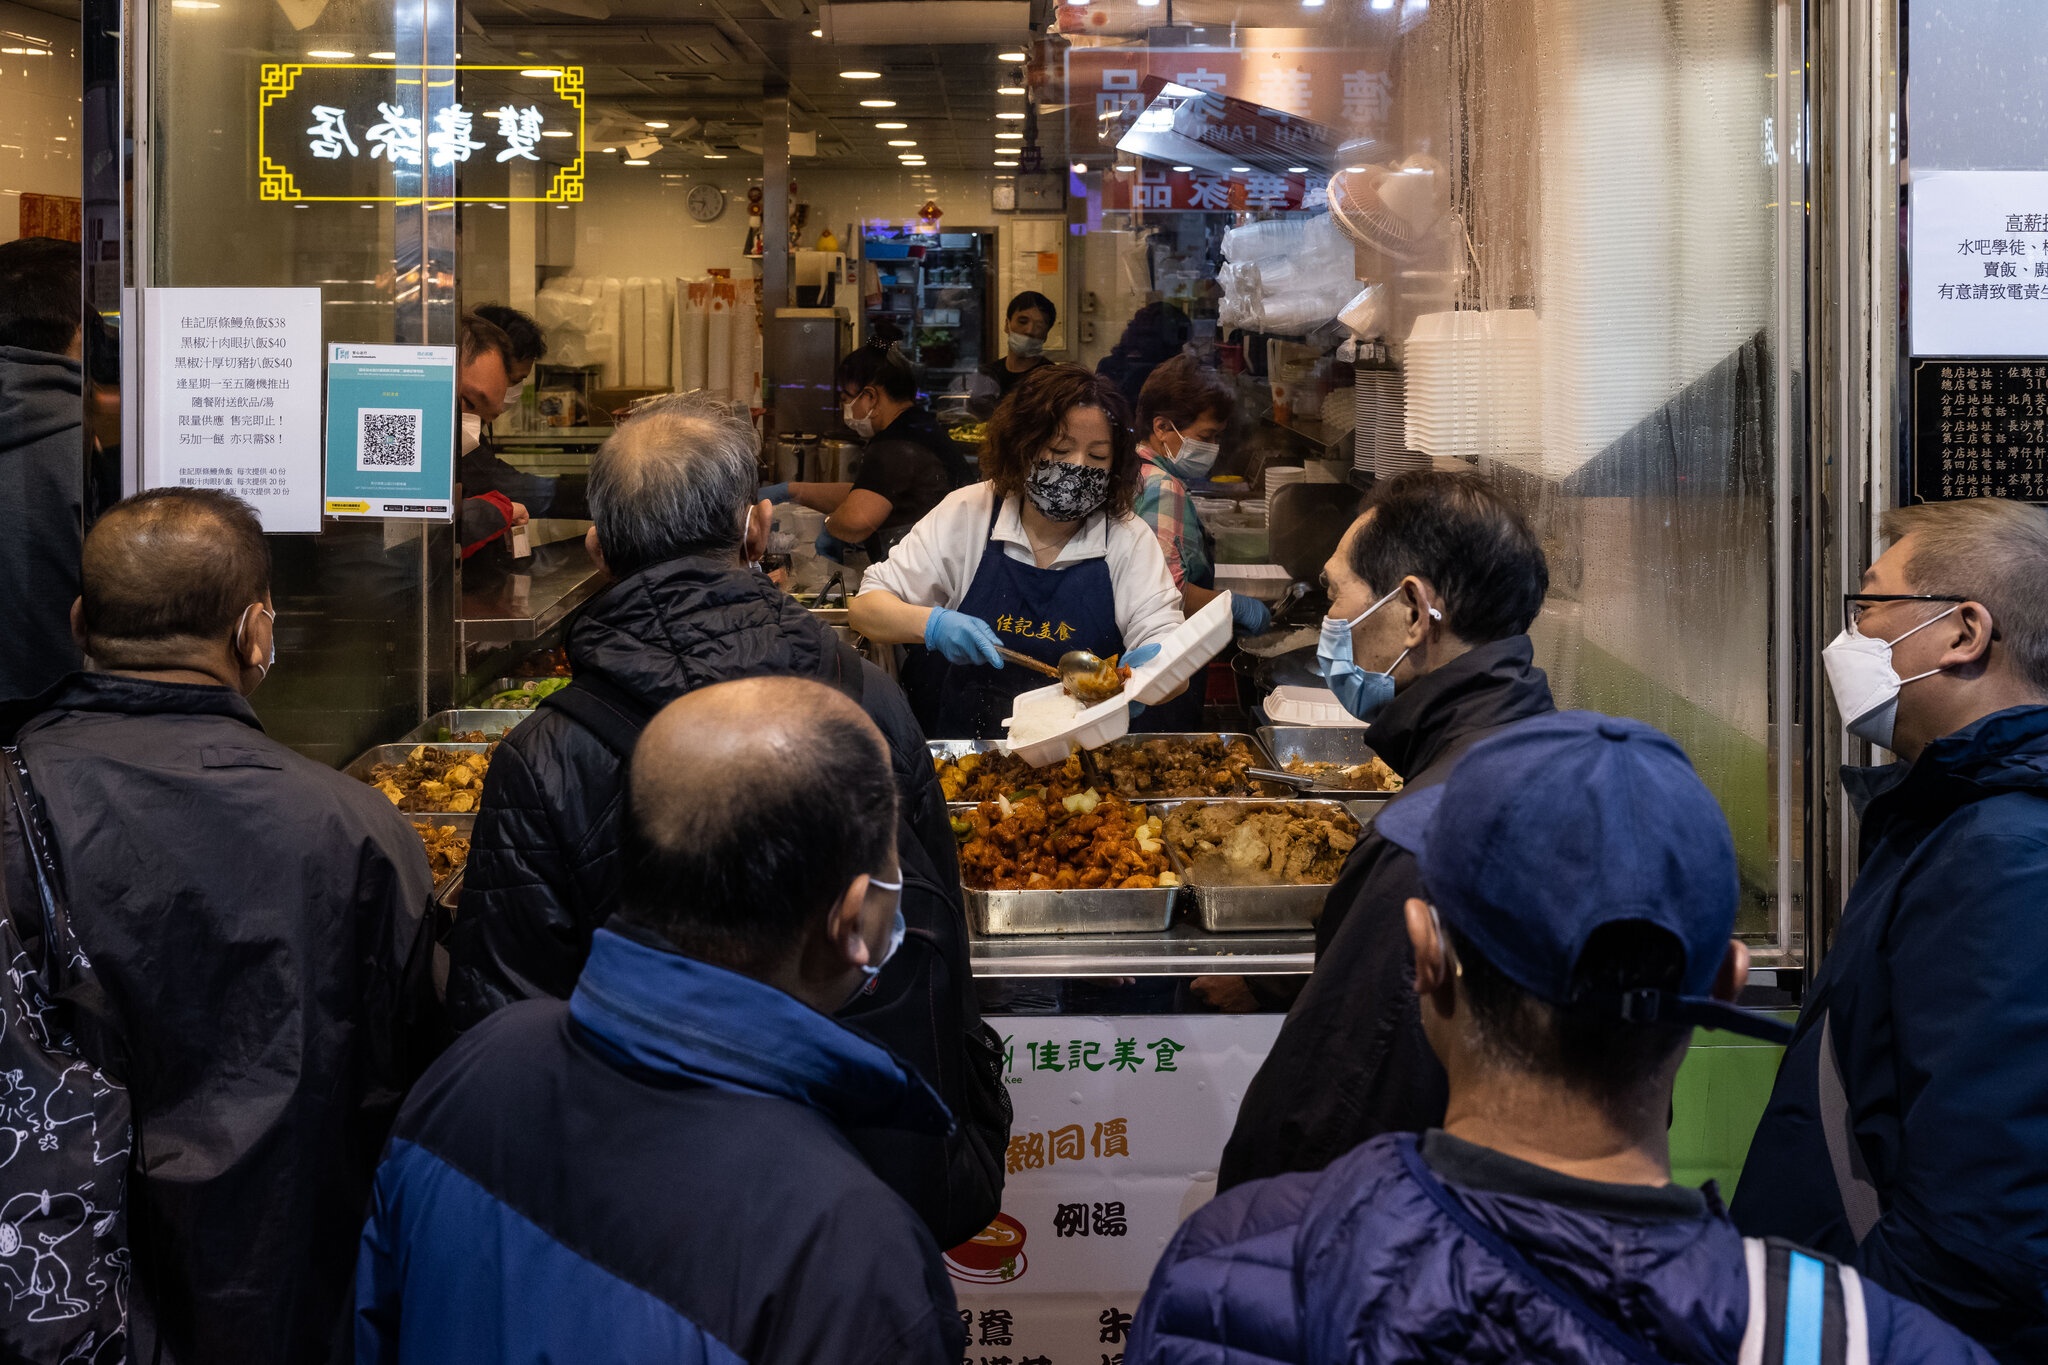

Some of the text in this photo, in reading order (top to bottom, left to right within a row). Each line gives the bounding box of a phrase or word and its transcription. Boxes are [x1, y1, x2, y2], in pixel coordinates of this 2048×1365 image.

[181, 316, 286, 329] 佳記原條鰻魚飯$38
[181, 336, 286, 349] 黑椒汁肉眼扒飯$40
[174, 356, 293, 369] 黑椒汁厚切豬扒飯$40
[176, 378, 290, 390] 逢星期一至五隨機推出
[191, 396, 274, 408] 隨餐附送飲品/湯
[2026, 405, 2048, 416] 25
[178, 415, 283, 426] 限量供應 售完即止！
[1941, 420, 2048, 432] 分店地址：長沙灣
[230, 433, 283, 445] 亦只需$8！
[2026, 432, 2048, 443] 26
[237, 467, 267, 475] 每次提供
[278, 467, 286, 475] 份
[237, 477, 267, 486] 每次提供
[269, 478, 277, 486] 20
[278, 477, 286, 486] 份
[241, 487, 271, 496] 每次提供
[273, 488, 281, 496] 20
[282, 487, 290, 496] 份
[2026, 485, 2048, 496] 26
[996, 613, 1076, 642] 佳記美食
[1026, 1037, 1185, 1073] 佳記美食
[1005, 1076, 1022, 1084] Kee
[1053, 1202, 1128, 1237] 例湯
